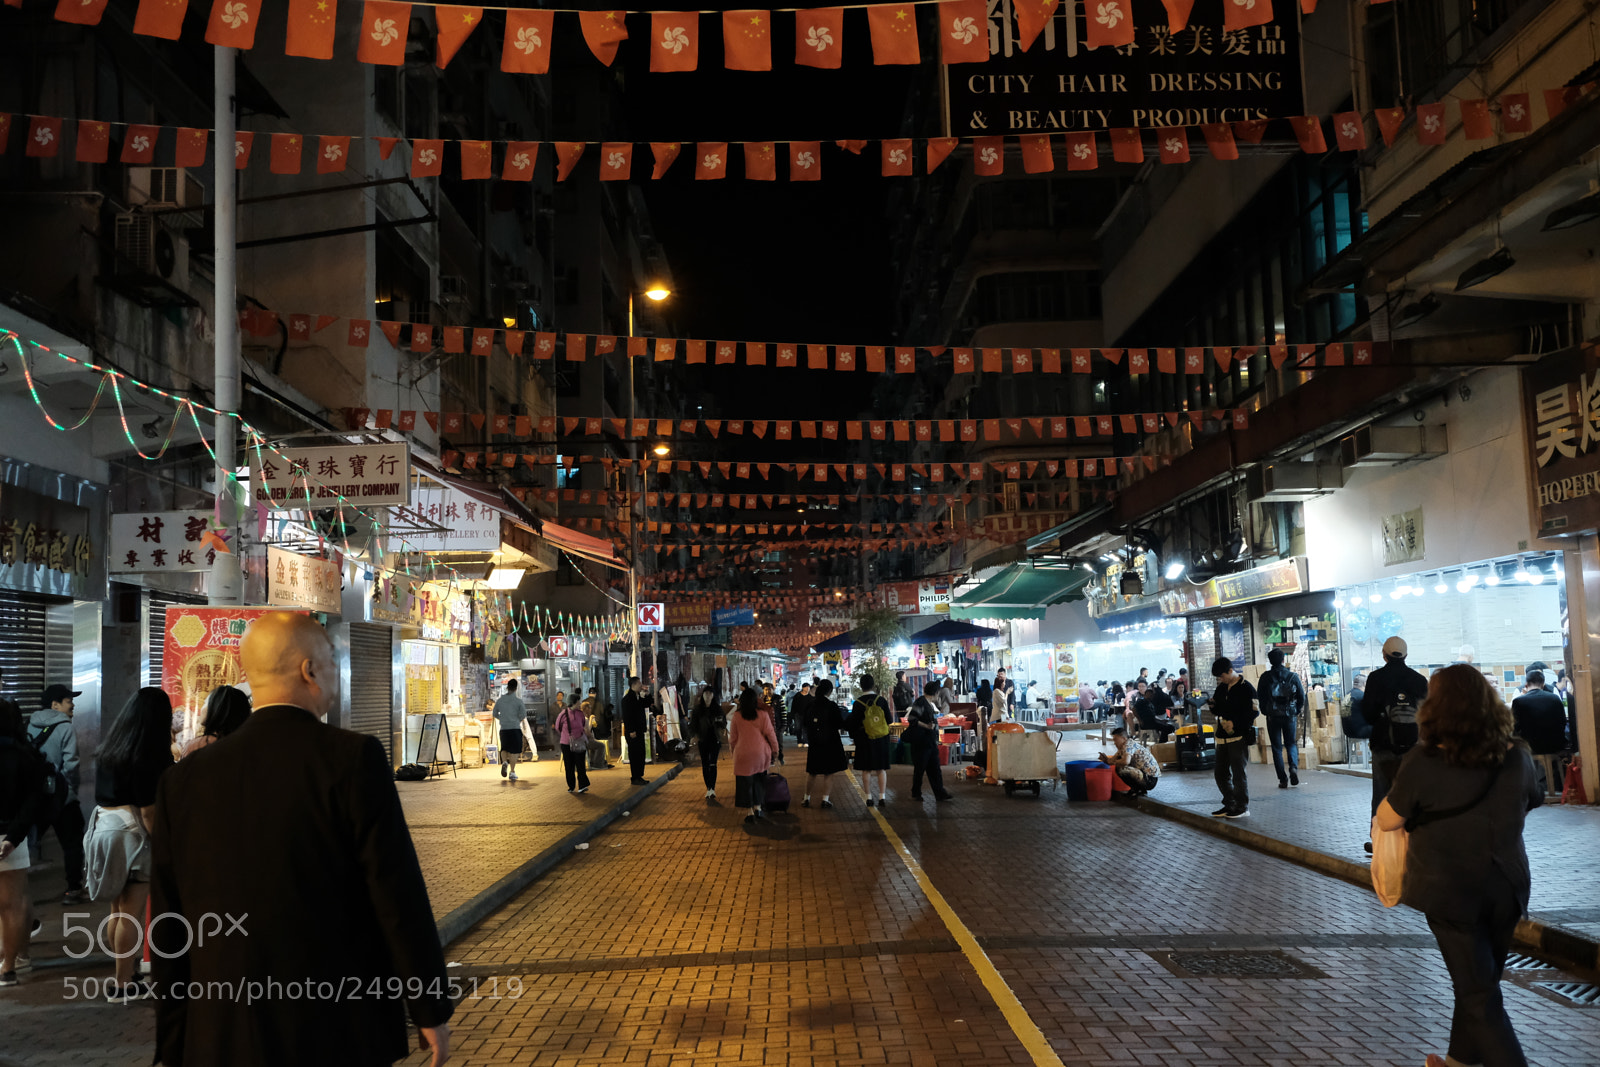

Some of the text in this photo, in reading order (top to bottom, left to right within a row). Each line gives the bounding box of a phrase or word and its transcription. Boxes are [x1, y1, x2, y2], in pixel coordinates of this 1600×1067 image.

[968, 71, 1283, 94] CITY HAIR DRESSING
[969, 107, 1269, 129] & BEAUTY PRODUCTS
[256, 454, 400, 481] 金聯珠寶行
[256, 486, 287, 501] GOLDEN
[316, 483, 362, 498] JEWELLERY
[362, 482, 400, 496] COMPANY
[483, 529, 497, 539] CO.
[920, 594, 951, 603] PHILIPS
[211, 617, 256, 635] 媽咪
